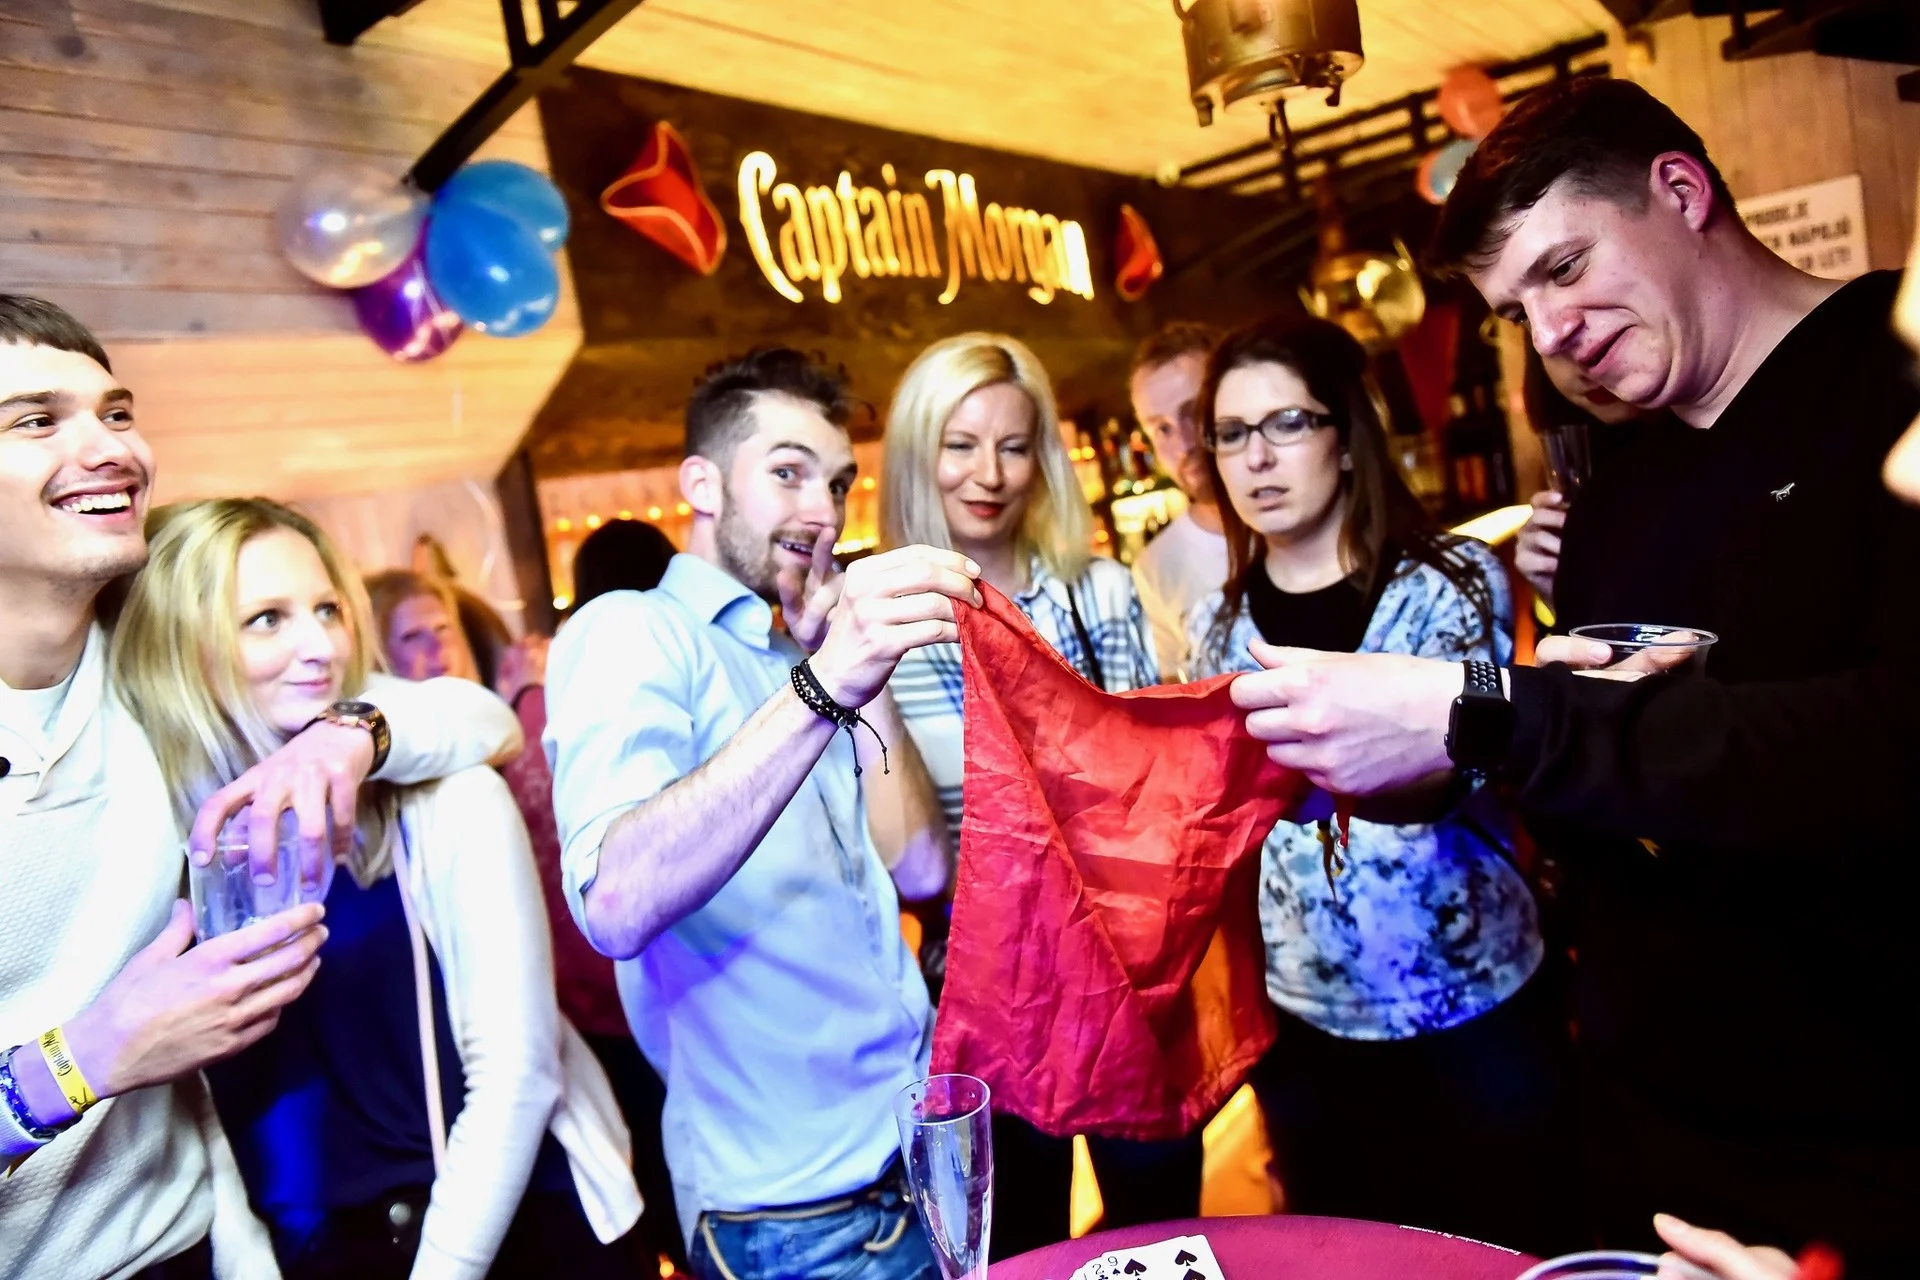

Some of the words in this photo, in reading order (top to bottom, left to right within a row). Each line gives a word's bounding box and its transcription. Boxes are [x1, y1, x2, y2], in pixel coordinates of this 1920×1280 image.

[738, 150, 941, 304] Captain
[924, 168, 1095, 305] Morgan
[49, 1045, 73, 1077] Captain
[1107, 1255, 1119, 1267] 9
